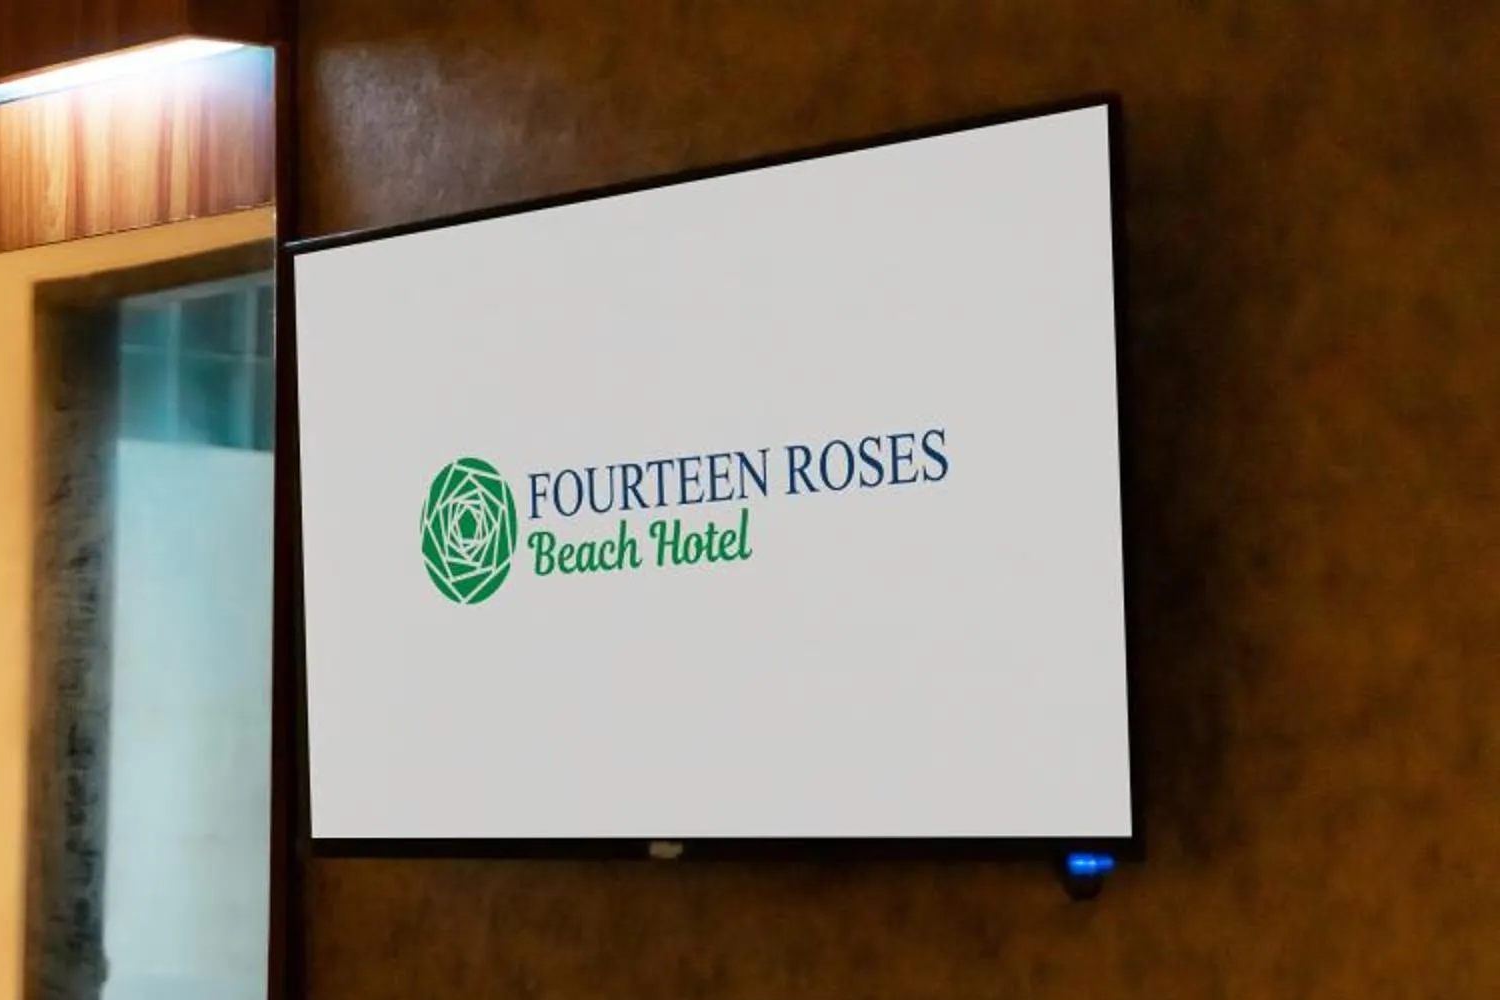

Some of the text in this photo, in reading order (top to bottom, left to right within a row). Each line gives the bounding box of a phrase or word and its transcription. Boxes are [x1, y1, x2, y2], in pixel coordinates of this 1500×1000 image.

[527, 428, 949, 520] FOURTEEN ROSES
[526, 507, 753, 577] Beach Hotel
